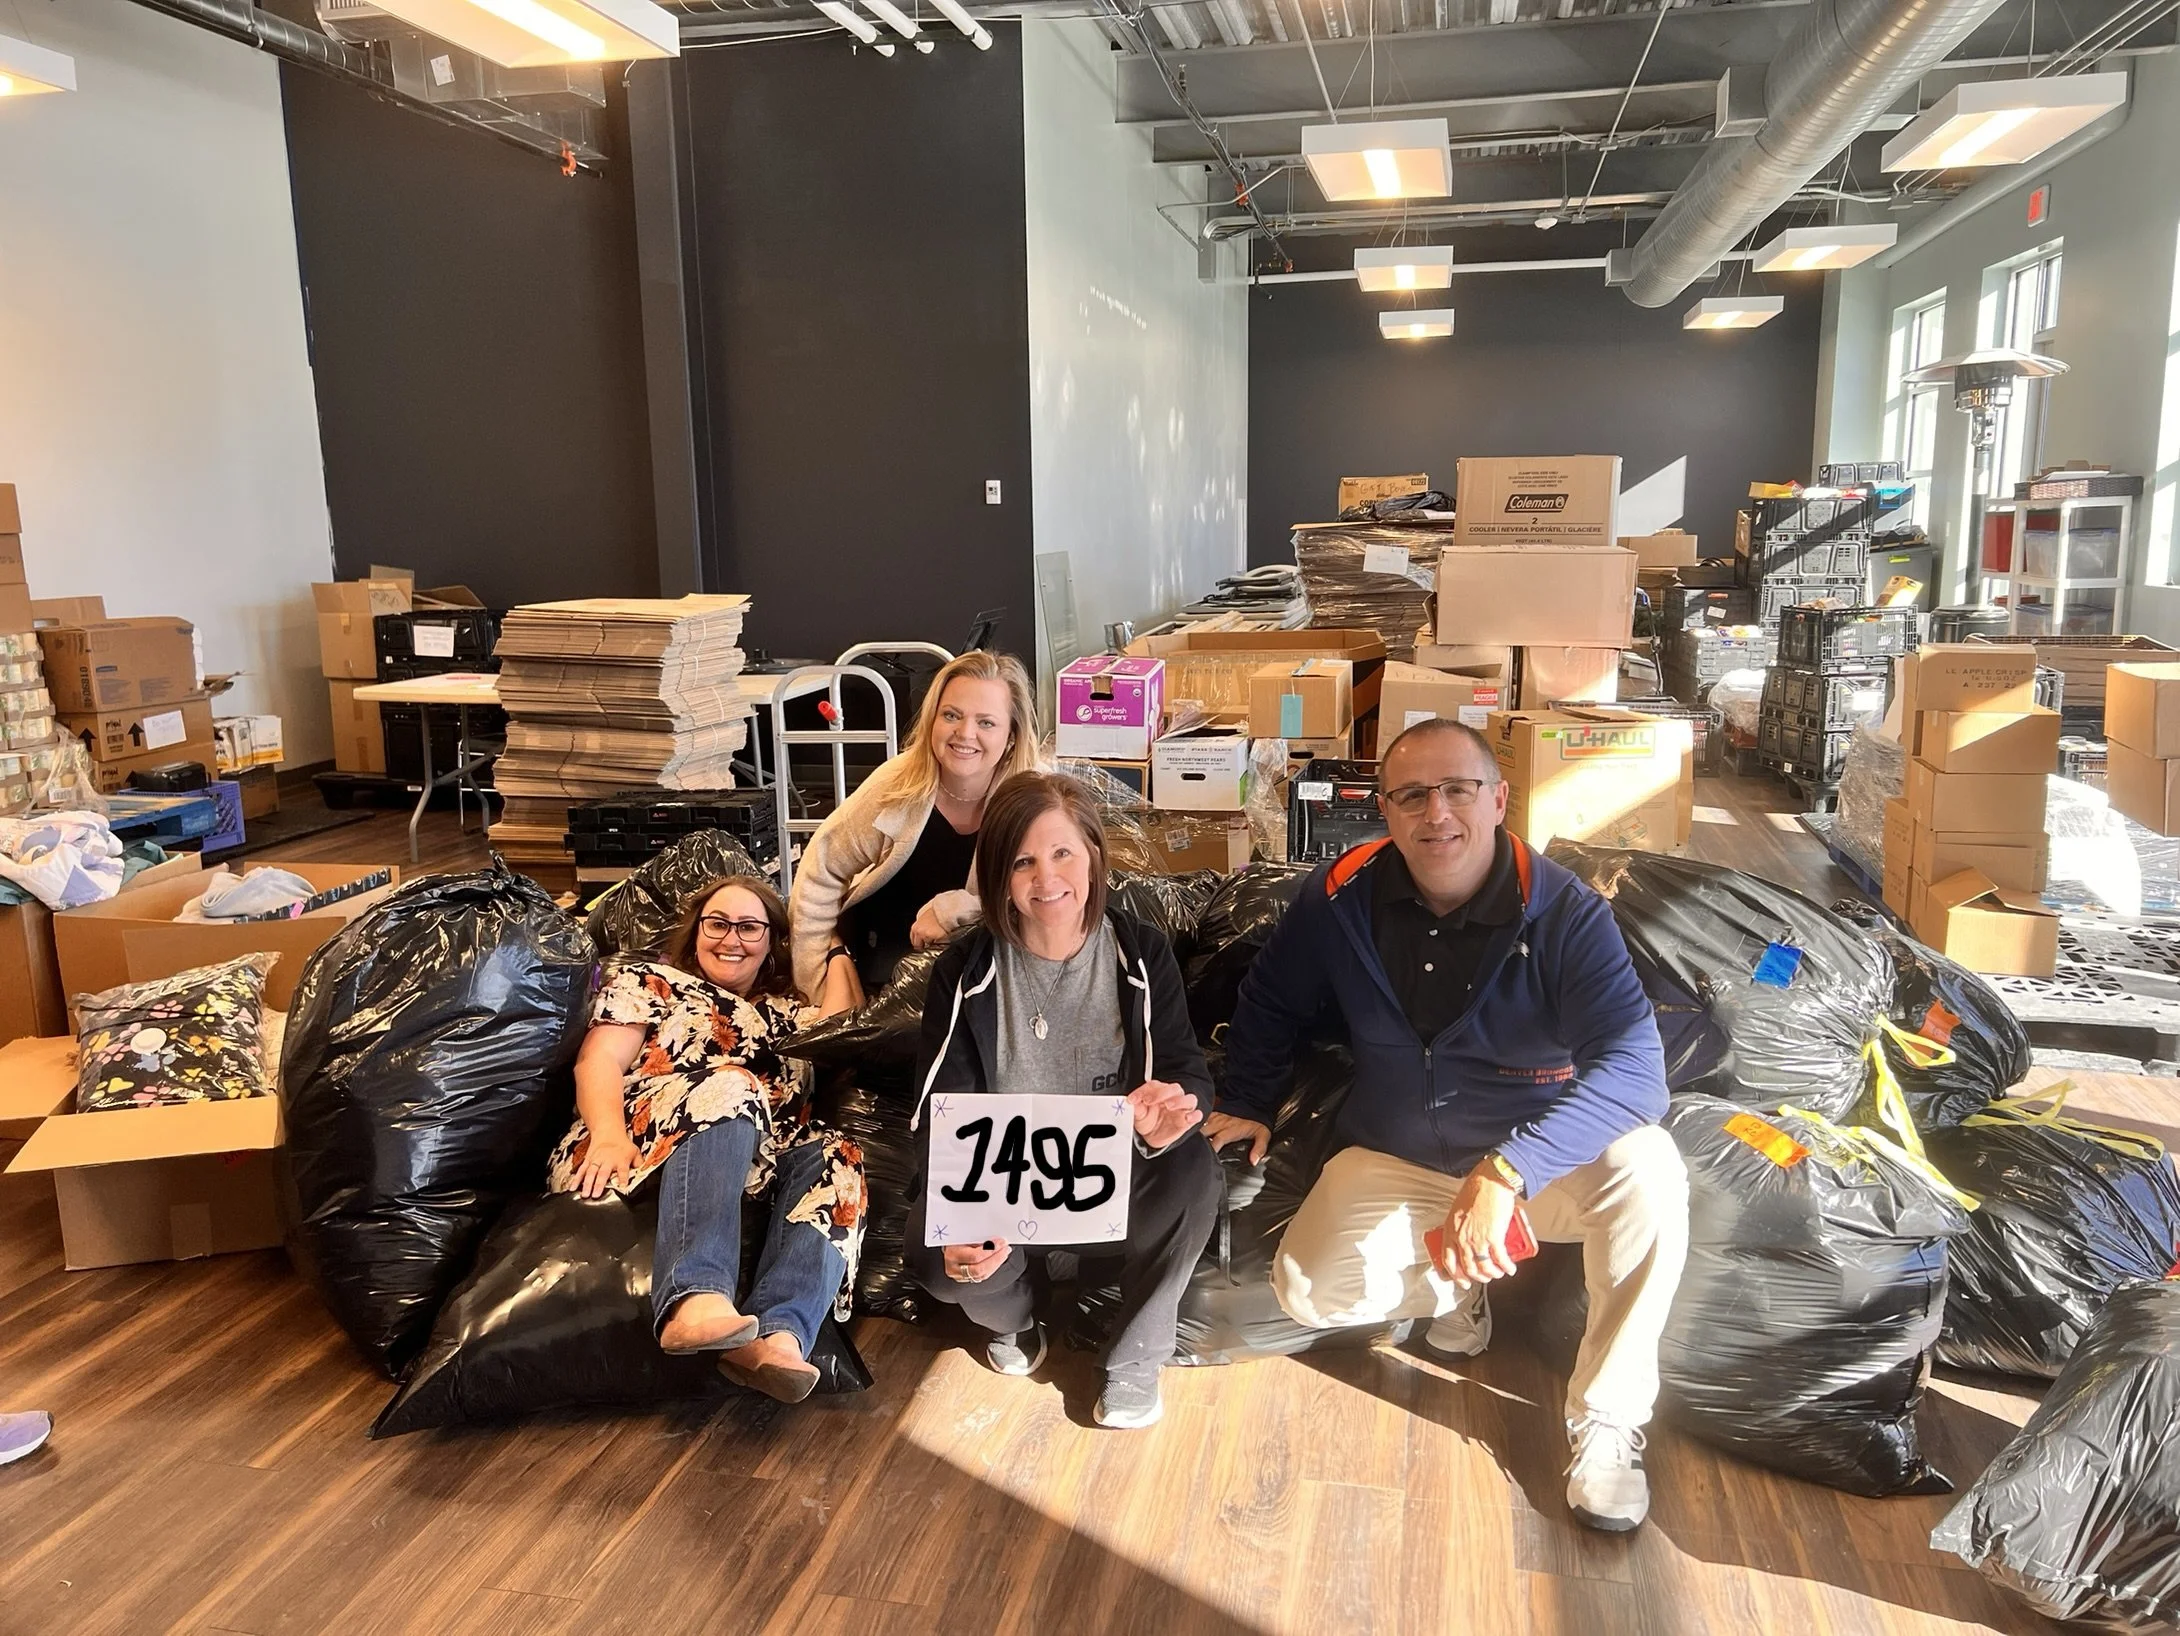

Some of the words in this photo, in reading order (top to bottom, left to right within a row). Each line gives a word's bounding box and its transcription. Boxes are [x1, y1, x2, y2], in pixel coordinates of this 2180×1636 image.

[1509, 495, 1554, 509] Coleman
[1531, 517, 1539, 525] 2
[1530, 525, 1562, 533] PORTÁTIL
[1567, 525, 1602, 533] GLACIÈRE
[1995, 668, 2028, 676] CRISP
[1093, 707, 1127, 715] superfresh
[1101, 714, 1127, 722] growers
[1566, 730, 1650, 748] U-HAUL
[1498, 1068, 1534, 1076] DENVER
[1535, 1064, 1573, 1076] BRONCOS
[941, 1115, 1117, 1212] 1495
